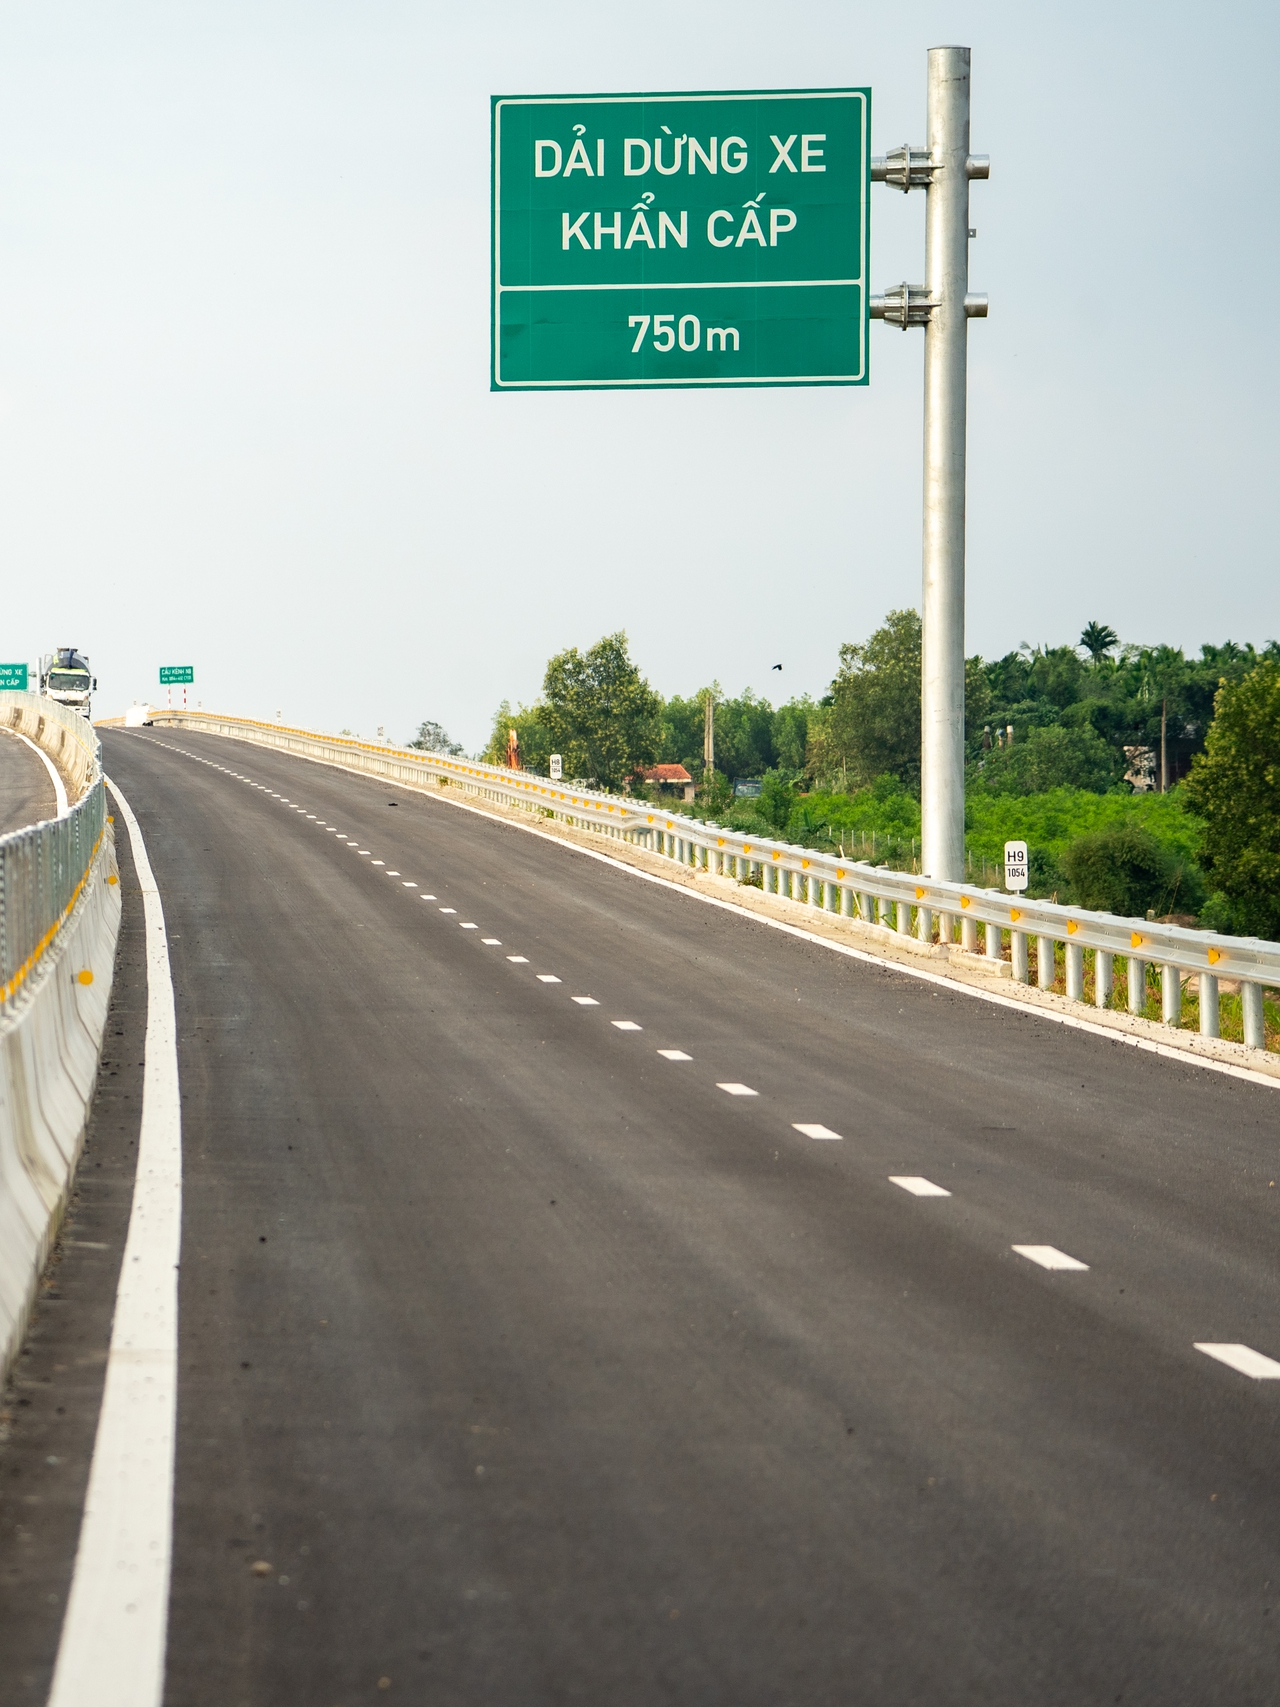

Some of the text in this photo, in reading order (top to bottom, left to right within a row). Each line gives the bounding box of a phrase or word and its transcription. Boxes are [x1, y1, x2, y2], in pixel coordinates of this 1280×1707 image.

[534, 123, 827, 178] DẢI DỪNG XE
[561, 191, 798, 251] KHẨN CẤP
[628, 314, 740, 353] 750m
[6, 677, 20, 686] CẤP
[1008, 851, 1024, 862] H9
[1007, 868, 1025, 877] 1054
